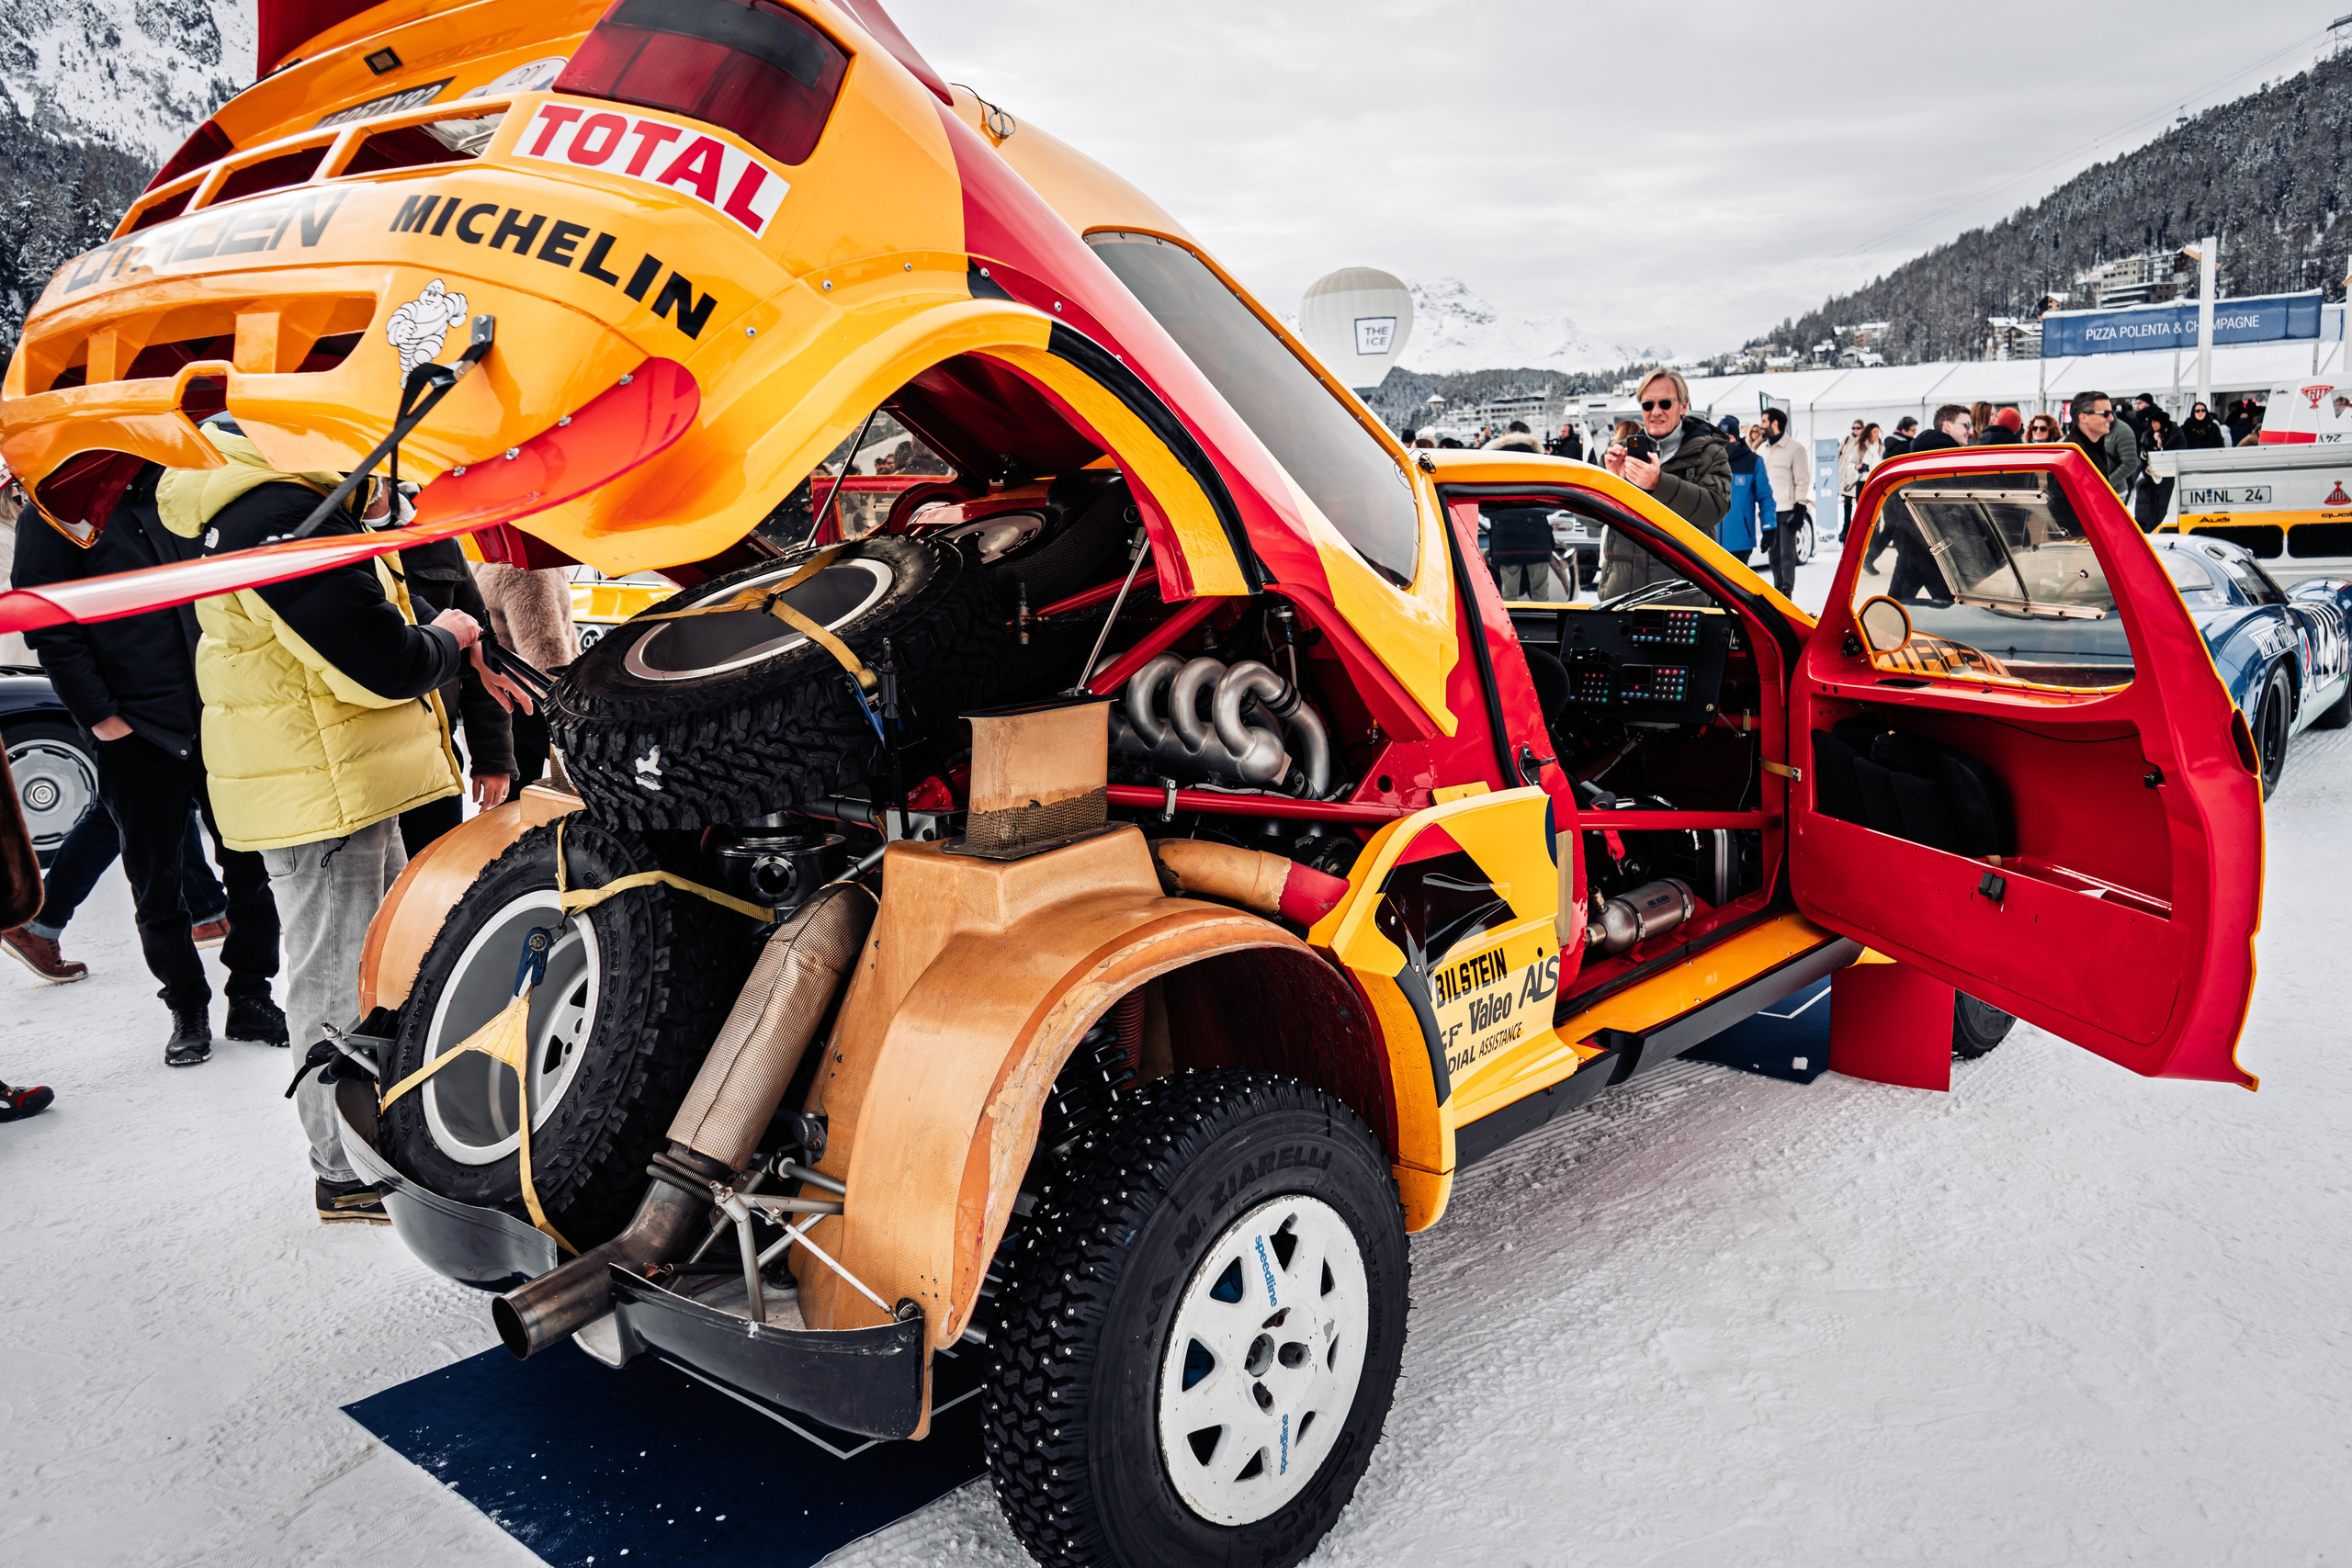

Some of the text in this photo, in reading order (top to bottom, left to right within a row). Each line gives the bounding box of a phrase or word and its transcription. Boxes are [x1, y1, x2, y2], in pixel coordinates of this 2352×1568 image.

[529, 104, 769, 234] TOTAL
[390, 194, 718, 340] MICHELIN
[1364, 326, 1388, 335] THE
[1365, 337, 1386, 345] ICE
[2086, 314, 2260, 341] PIZZA POLENTA & CHMPAGNE
[2190, 489, 2263, 503] IN NL 24
[1434, 947, 1509, 1010] BILSTEIN
[1468, 991, 1512, 1035] Valeo
[1478, 1021, 1523, 1059] ASSISTANCE
[1209, 1145, 1333, 1217] ZIARELLI
[1254, 1234, 1278, 1308] speedline
[1279, 1413, 1289, 1476] speedline
